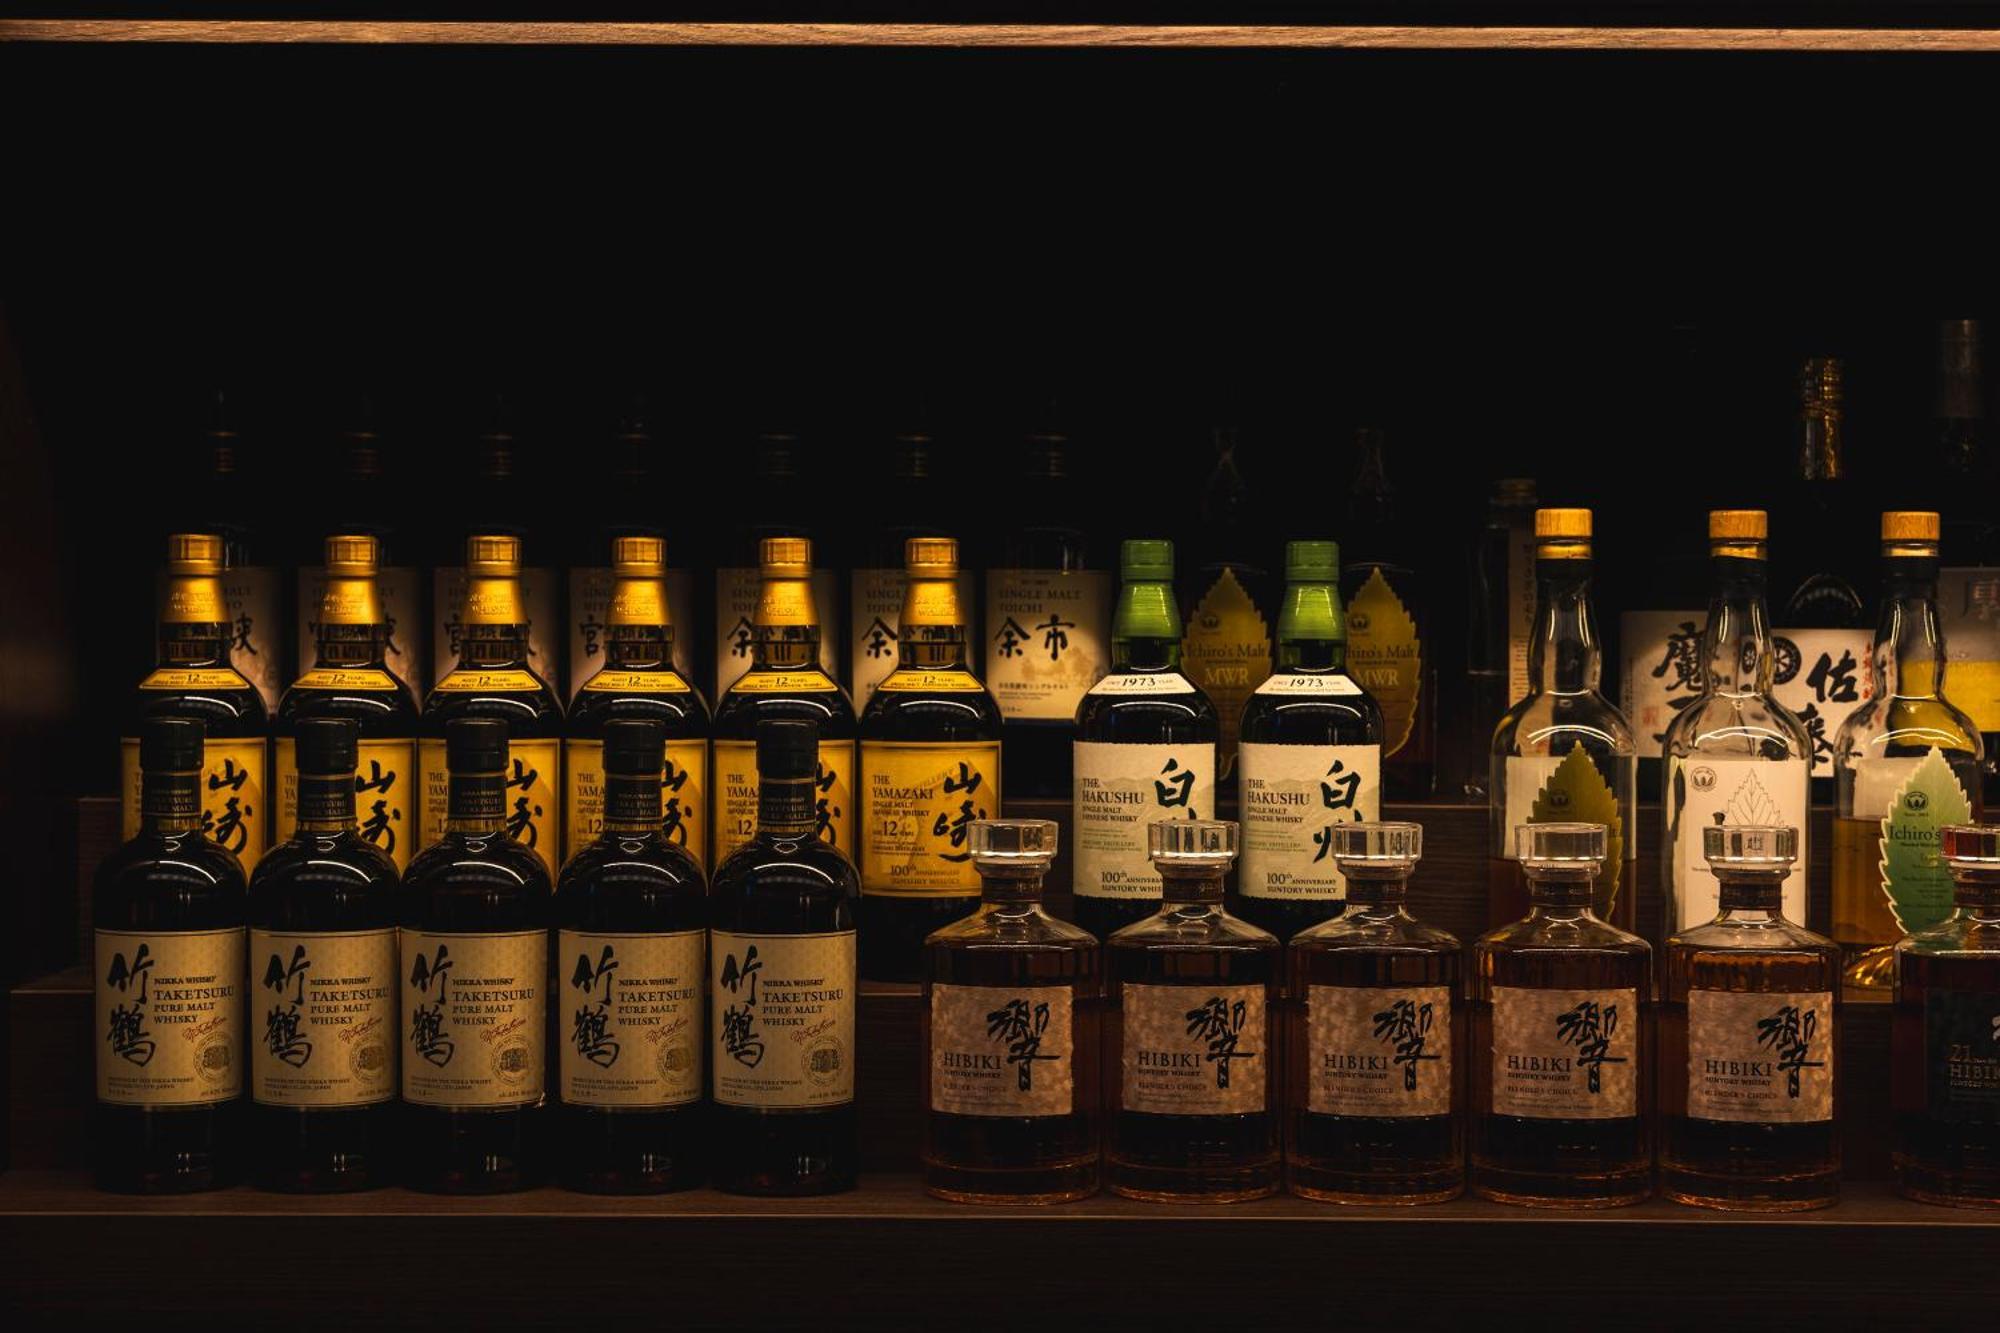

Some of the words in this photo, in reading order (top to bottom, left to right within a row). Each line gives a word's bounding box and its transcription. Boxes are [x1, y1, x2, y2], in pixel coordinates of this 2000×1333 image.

[1047, 590, 1080, 600] MALT
[862, 616, 898, 658] 余
[994, 614, 1075, 661] 余市
[478, 675, 491, 686] 12
[628, 675, 641, 685] 12
[775, 676, 789, 686] 12
[923, 675, 936, 685] 12
[1122, 678, 1156, 686] 1973
[1205, 668, 1249, 686] MWR
[1290, 678, 1324, 687] 1973
[1355, 668, 1399, 686] MWR
[428, 772, 445, 782] THE
[577, 773, 595, 783] THE
[726, 774, 745, 783] THE
[873, 775, 890, 784] THE
[1082, 778, 1099, 788] THE
[1248, 779, 1265, 789] THE
[726, 787, 758, 797] YAMA
[872, 787, 934, 799] YAMAZAKI
[1082, 791, 1144, 804] HAKUSHU
[1248, 792, 1310, 805] HAKUSHU
[738, 820, 752, 835] 12
[884, 821, 897, 837] 12
[1889, 825, 1941, 840] Ichiro's
[154, 986, 234, 1000] TAKETSURU
[452, 988, 535, 1002] TAKETSURU
[762, 990, 844, 1003] TAKETSURU
[107, 943, 156, 1067] 竹鶴
[154, 1004, 184, 1012] PURE
[187, 1002, 215, 1011] MALT
[264, 945, 313, 1068] 竹鶴
[310, 1006, 340, 1014] PURE
[343, 1004, 371, 1012] MALT
[411, 944, 454, 1068] 竹鶴
[453, 1005, 482, 1014] PURE
[485, 1004, 513, 1013] MALT
[571, 945, 619, 1068] 竹鶴
[618, 1006, 647, 1014] PURE
[650, 1004, 678, 1013] MALT
[721, 945, 764, 1069] 竹鶴
[763, 1006, 791, 1014] PURE
[795, 1005, 824, 1014] MALT
[154, 1015, 198, 1024] WHISKY
[310, 1016, 354, 1025] WHISKY
[453, 1016, 496, 1025] WHISKY
[618, 1017, 661, 1025] WHISKY
[763, 1018, 805, 1026] WHISKY
[943, 1052, 1001, 1069] HIBIKI
[1138, 1051, 1200, 1067] HIBIKI
[1325, 1054, 1387, 1069] HIBIKI
[1508, 1056, 1570, 1071] HIBIKI
[1706, 1060, 1771, 1076] HIBIKI
[1951, 1065, 2000, 1080] HIBIK
